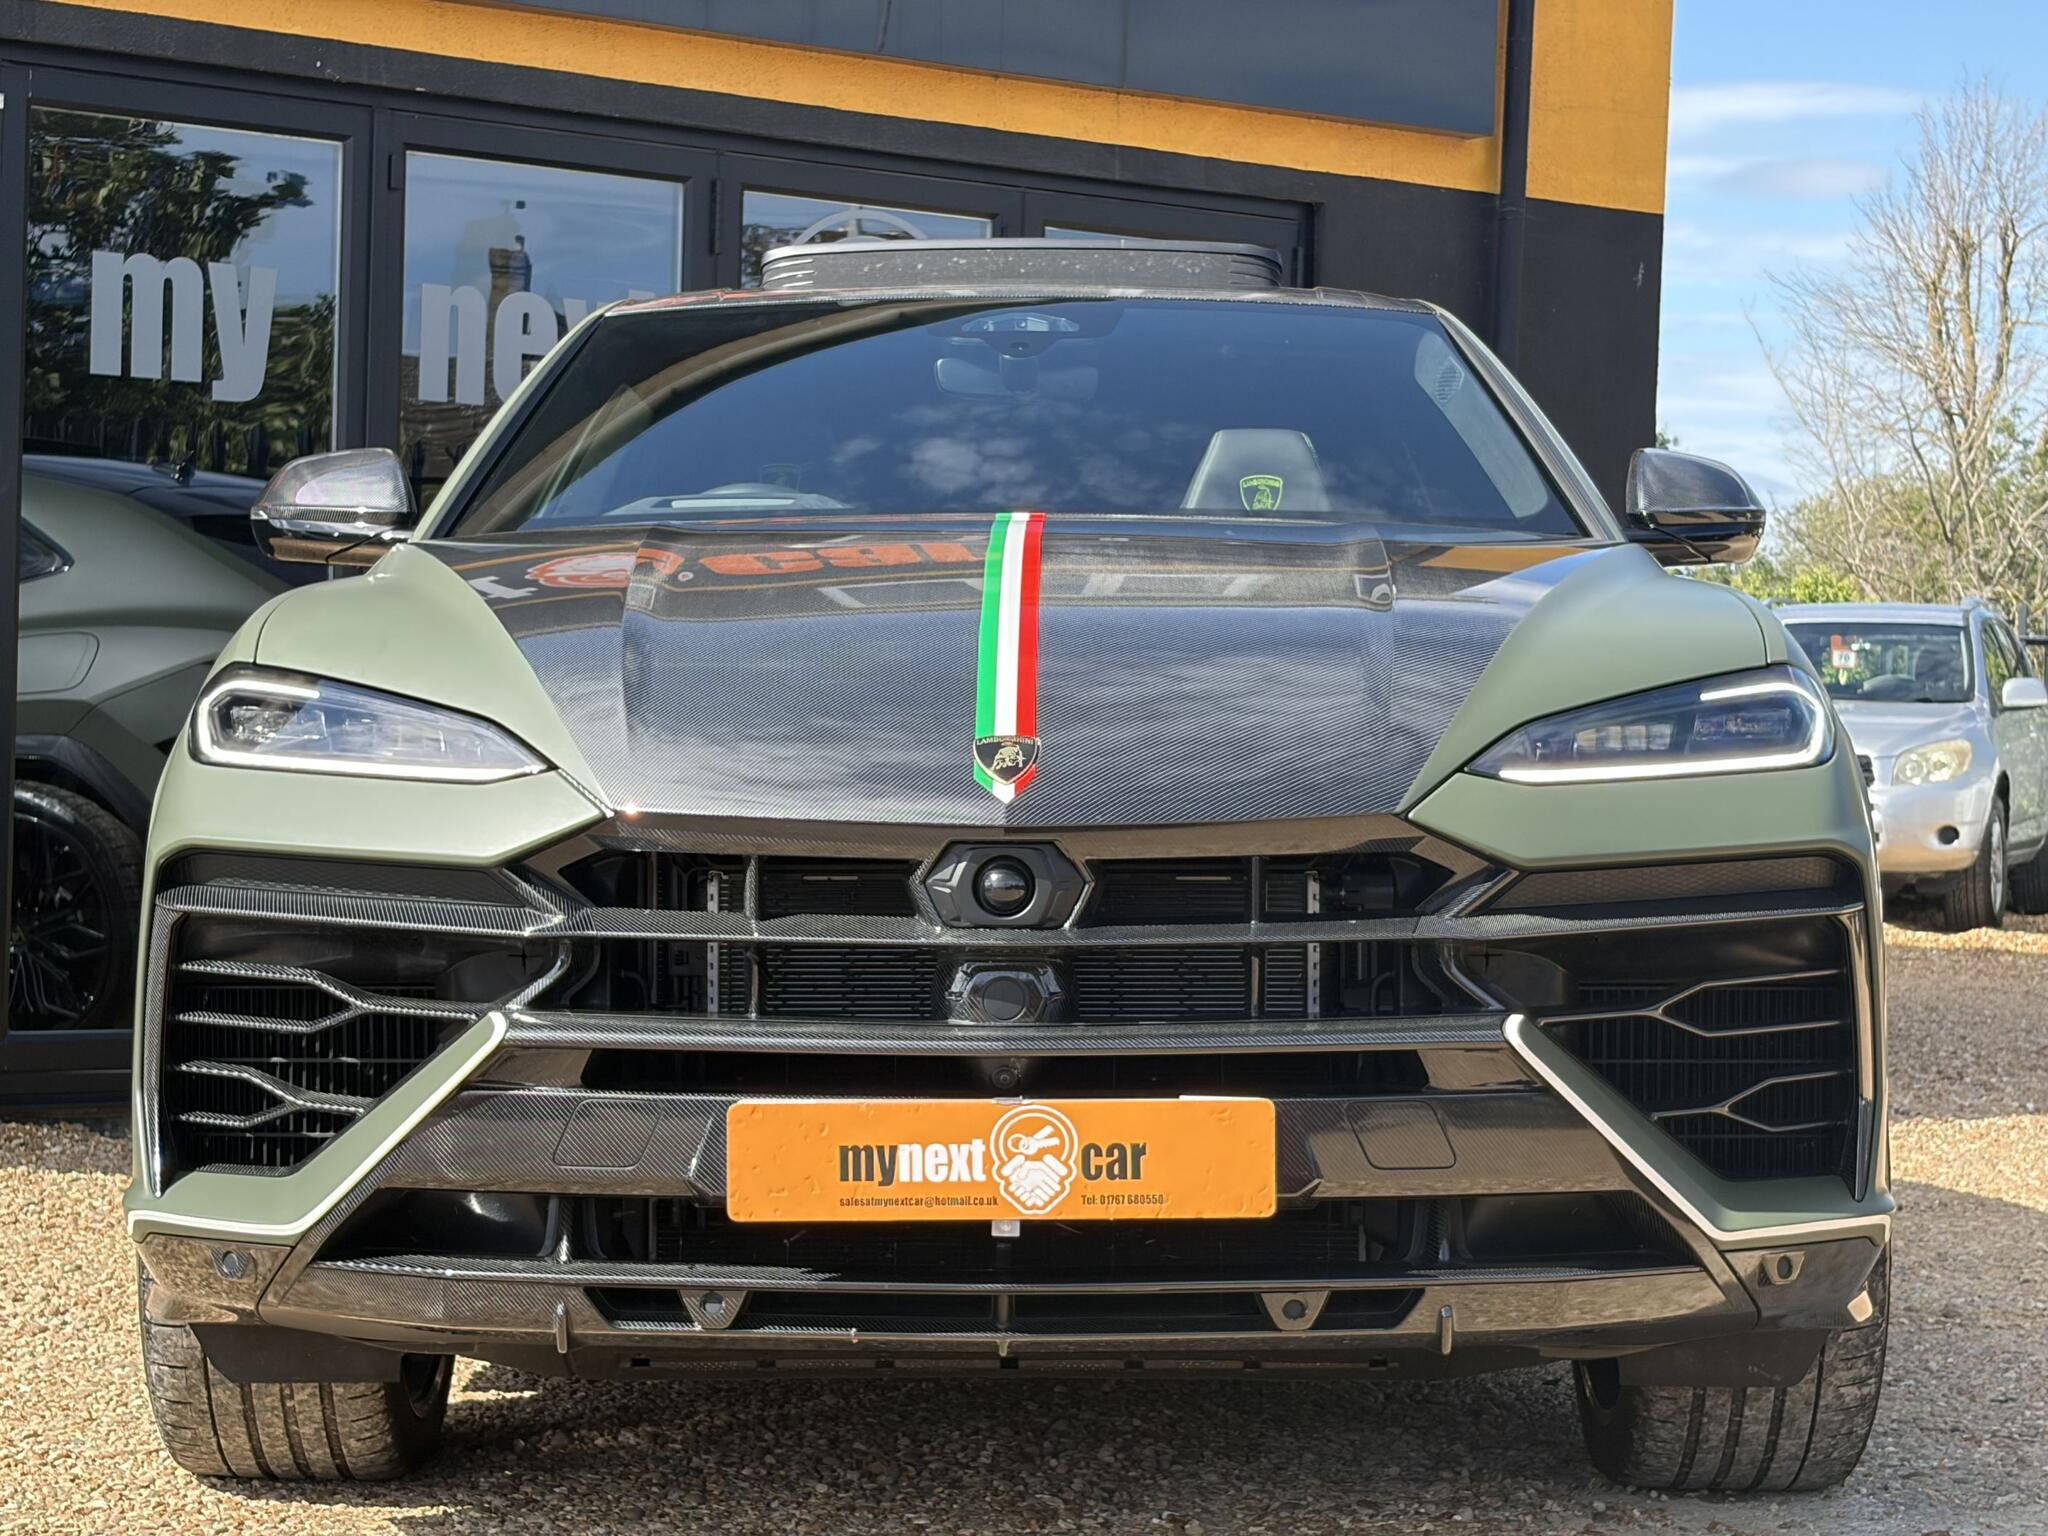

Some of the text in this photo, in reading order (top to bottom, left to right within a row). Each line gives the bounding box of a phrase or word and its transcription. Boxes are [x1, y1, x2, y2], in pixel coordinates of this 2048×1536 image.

[90, 250, 656, 406] my ne
[1081, 1142, 1147, 1181] car
[839, 1195, 999, 1208] salesatmynextcar@hotmail.co.uk
[1081, 1194, 1164, 1205] Tel: 01767 680550
